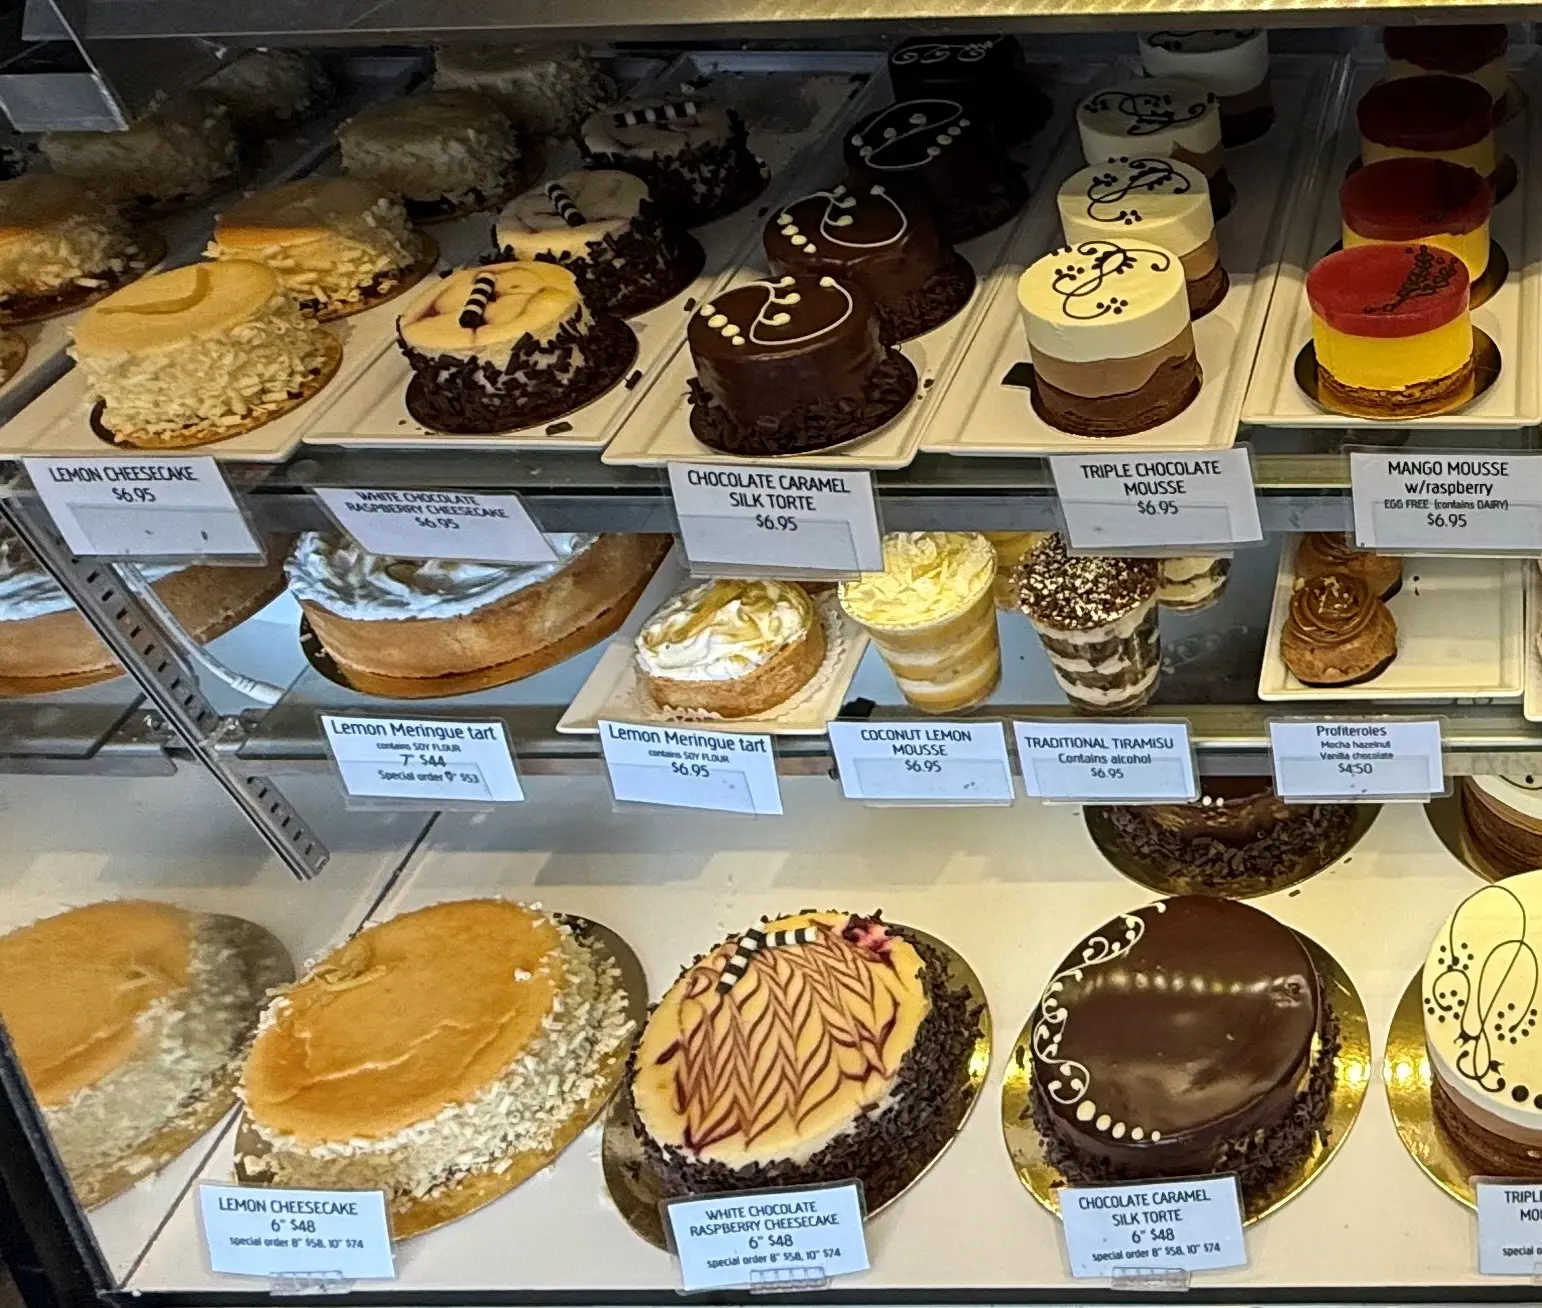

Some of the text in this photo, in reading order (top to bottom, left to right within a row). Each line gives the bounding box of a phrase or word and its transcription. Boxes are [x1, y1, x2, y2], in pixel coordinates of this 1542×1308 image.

[49, 466, 198, 482] LEMON CHEESECAKE
[1080, 460, 1222, 479] TRIPLE CHOCOLATE
[1388, 461, 1509, 476] MANGO MOUSSE
[687, 470, 851, 494] CHOCOLATE CARAMEL
[1123, 480, 1187, 496] MOUSSE
[1404, 480, 1494, 496] w/raspberry
[112, 487, 156, 502] $6.95
[355, 492, 481, 505] WHITE CHOCOLATE
[729, 492, 816, 511] SILK TORTE
[344, 502, 510, 518] RASPBERRY CHEESECAKE
[1138, 500, 1178, 515] $6.95
[1384, 499, 1509, 510] EGG FREE (contains DAIRY)
[415, 517, 460, 529] $6.95
[756, 514, 798, 532] $6.95
[1427, 513, 1467, 528] $6.95
[331, 720, 497, 741] Lemon Meringue tart
[860, 729, 972, 742] COCONUT LEMON
[1316, 726, 1387, 737] Profiteroles
[608, 724, 767, 753] Lemon Meringue tart
[1024, 737, 1174, 749] TRADITIONAL TIRAMISU
[1352, 741, 1391, 749] hazelnut
[892, 744, 948, 756] MOUSSE
[1320, 752, 1394, 760] Vanilla chocolate
[905, 759, 942, 772] $6.95
[1058, 753, 1151, 764] Contains alcohol
[671, 762, 709, 778] $6.95
[1091, 768, 1124, 779] $6.95
[1338, 762, 1373, 774] $4.50
[218, 1197, 359, 1215] LEMON CHEESECAKE
[1078, 1189, 1212, 1210] CHOCOLATE CARAMEL
[705, 1201, 818, 1221] WHITE CHOCOLATE
[1112, 1209, 1183, 1227] SILK TORTE
[271, 1219, 316, 1233] 6" $48
[689, 1214, 840, 1236] RASPBERRY CHEESECAKE
[748, 1234, 794, 1249] 6" $48
[1131, 1228, 1175, 1243] 6" $48
[706, 1256, 740, 1269] special
[742, 1254, 767, 1264] order
[770, 1252, 780, 1263] 8"
[806, 1249, 820, 1260] 10"
[823, 1248, 841, 1258] $74
